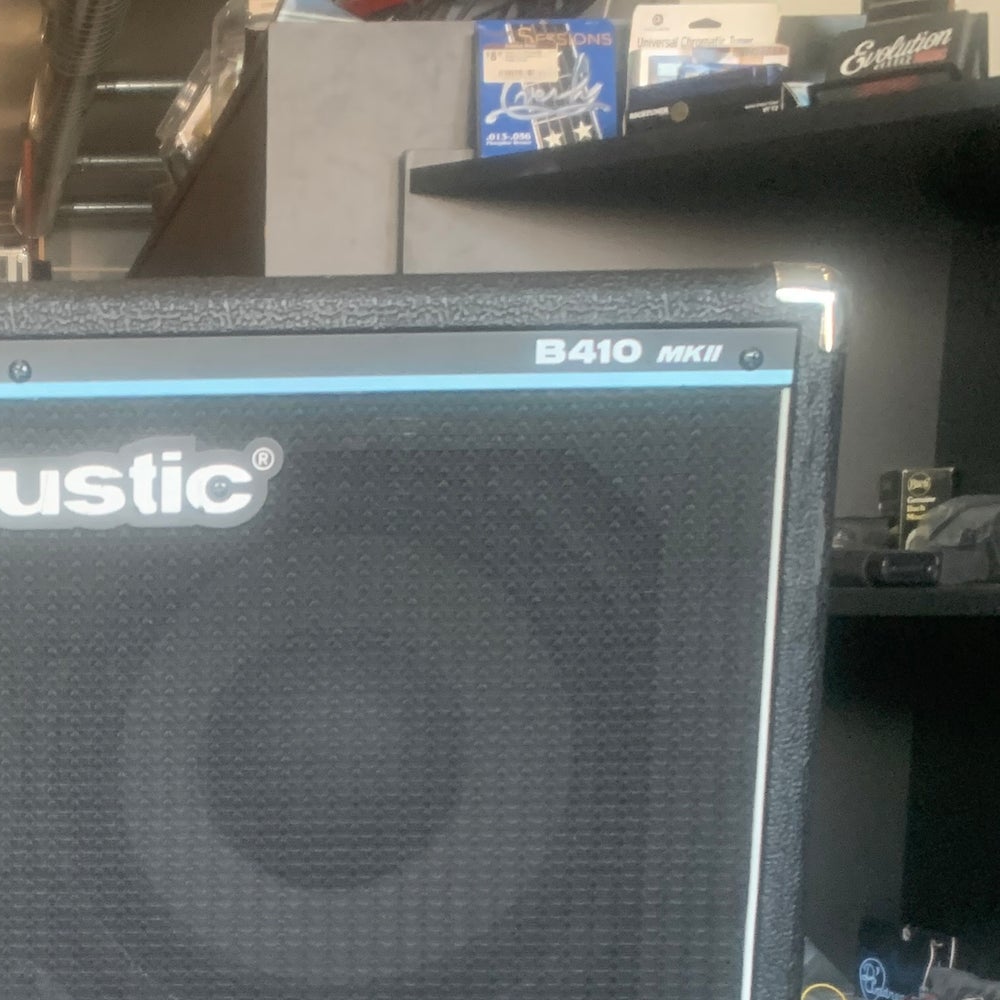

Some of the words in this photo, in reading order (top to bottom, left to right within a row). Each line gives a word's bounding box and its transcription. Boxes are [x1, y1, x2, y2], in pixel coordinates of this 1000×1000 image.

[517, 27, 612, 46] SESSIONS
[637, 37, 679, 48] Universal
[840, 28, 953, 76] Evolution
[535, 338, 643, 365] B410
[656, 344, 724, 363] MKII
